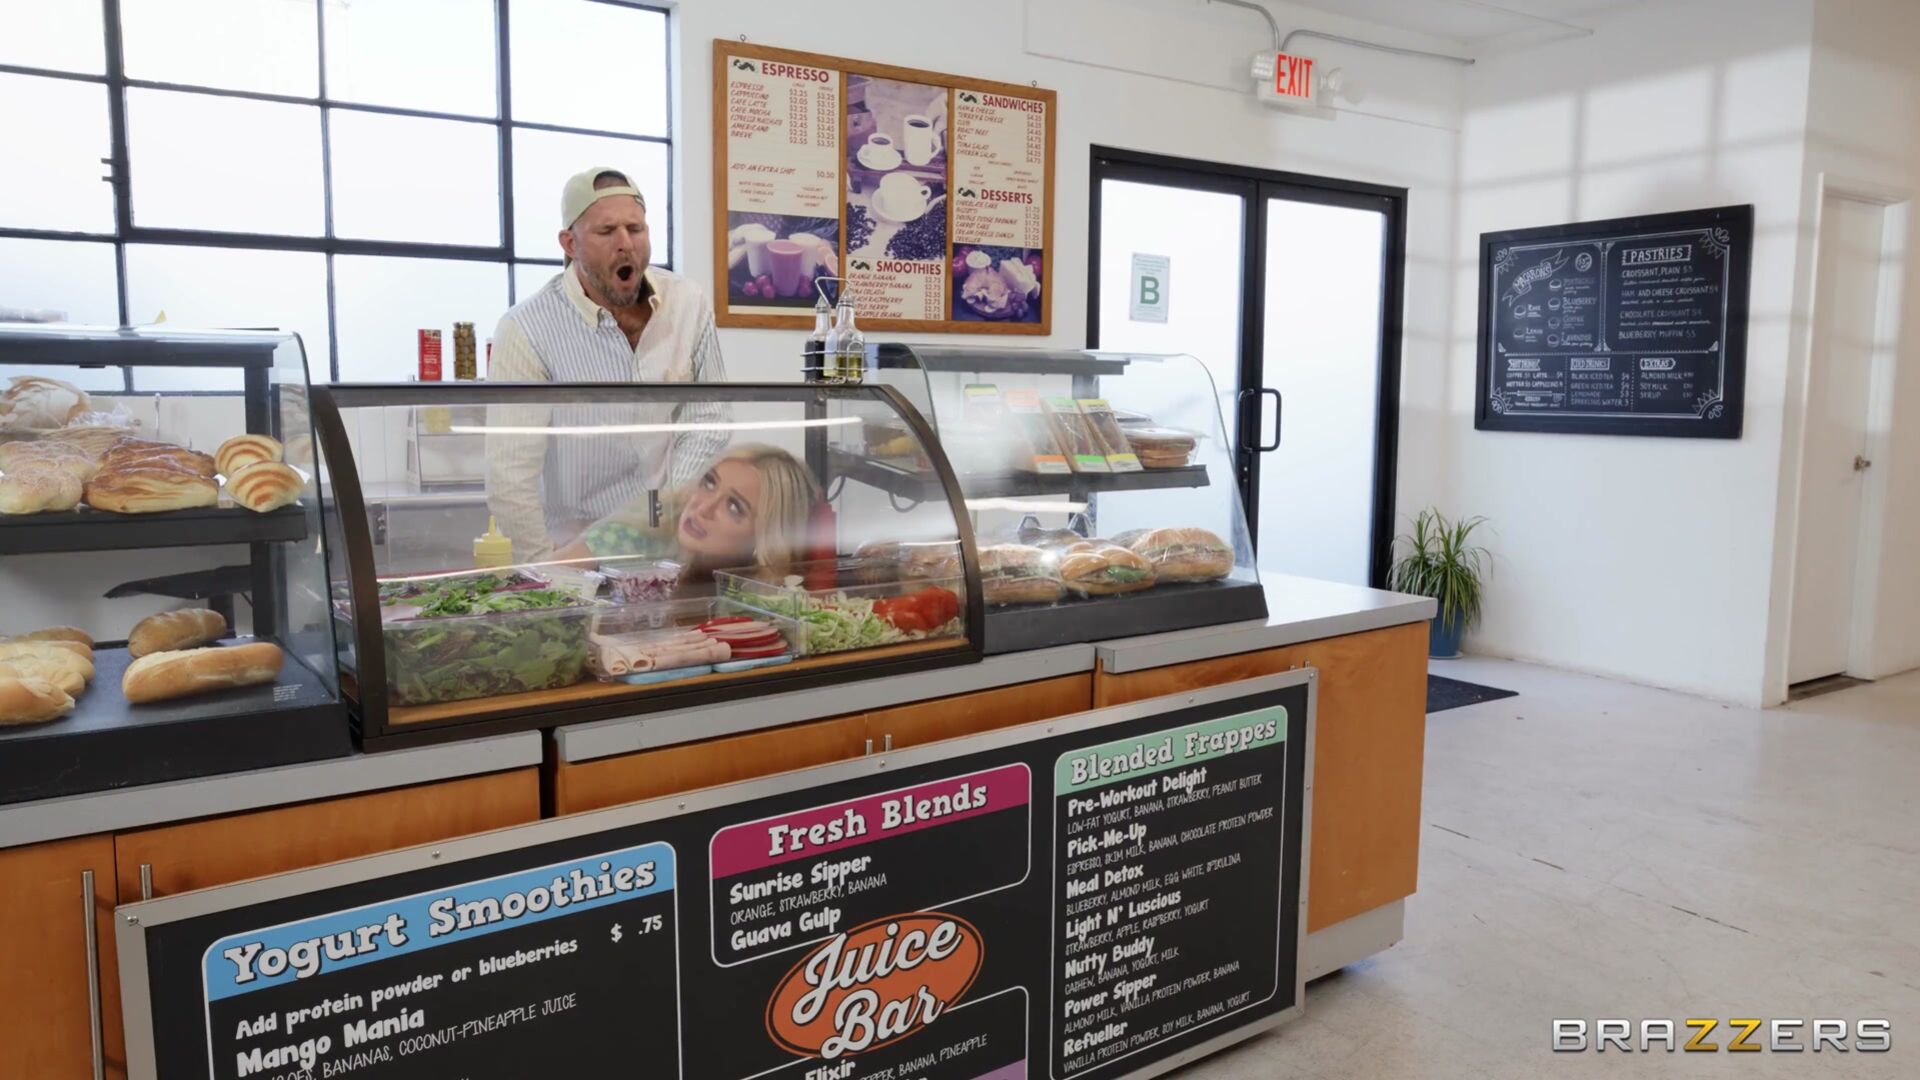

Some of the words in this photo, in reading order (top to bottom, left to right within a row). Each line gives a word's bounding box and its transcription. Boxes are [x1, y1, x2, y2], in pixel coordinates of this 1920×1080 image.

[762, 62, 830, 83] ESPRESSO
[1277, 54, 1312, 98] EXIT
[983, 95, 1043, 114] SANDWICHES
[981, 189, 1033, 204] DESSERTS
[876, 261, 941, 275] SMOOTHIES
[1631, 247, 1683, 263] PASTRIES
[1140, 275, 1160, 305] B
[1638, 289, 1652, 297] AND
[1652, 288, 1673, 297] CHEESE
[1618, 329, 1657, 340] BLUEBERRY
[1071, 737, 1174, 785] Blended
[1184, 719, 1277, 759] Frappes
[1068, 780, 1158, 817] Pre-Workout
[1163, 766, 1207, 794] Delight
[1068, 815, 1101, 835] LOW-FAT
[1103, 809, 1132, 827] YOGURT,
[1212, 779, 1238, 797] PEANUT
[1239, 774, 1262, 790] BUTTER
[768, 809, 867, 857] Fresh
[881, 783, 988, 830] Blends
[1067, 823, 1147, 858] Pick-Me-Up
[1105, 853, 1124, 866] SKIM
[1180, 825, 1217, 843] CHOCOLATE
[1218, 816, 1247, 833] PROTEIN
[1247, 807, 1274, 825] POWDER
[730, 872, 804, 905] Sunrise
[811, 856, 872, 890] Sipper
[730, 901, 776, 926] ORANGE,
[779, 884, 846, 914] STRAWBERRY,
[848, 873, 887, 895] BANANA
[1066, 898, 1109, 917] BLUEBERRY,
[1111, 885, 1140, 906] ALMOND
[1164, 871, 1180, 885] EGG
[1206, 853, 1241, 873] SPIRULINA
[1067, 874, 1099, 899] Meal
[1104, 864, 1144, 886] Detox
[224, 913, 409, 984] Yogurt
[429, 860, 656, 937] Smoothies
[610, 922, 623, 943] $
[638, 914, 663, 935] .75
[731, 920, 792, 951] Guava
[799, 907, 841, 934] Gulp
[1065, 935, 1114, 956] STRAWBERRY,
[1184, 898, 1210, 916] YOGURT
[1066, 913, 1101, 942] Light
[1107, 906, 1124, 926] N'
[1128, 891, 1182, 918] Luscious
[792, 921, 963, 1025] Juice
[1065, 952, 1107, 979] Nutty
[1112, 937, 1155, 962] Buddy
[1161, 946, 1180, 962] MILK
[236, 1012, 277, 1040] Add
[286, 993, 363, 1035] protein
[371, 974, 444, 1012] powder
[451, 966, 473, 984] or
[479, 939, 578, 977] blueberries
[1064, 991, 1108, 1018] Power
[1113, 974, 1158, 1001] Sipper
[1064, 1017, 1095, 1035] ALMOND
[1120, 994, 1151, 1014] VANILLA
[1152, 981, 1182, 1003] PROTEIN
[1213, 960, 1240, 979] BANANA
[236, 1035, 332, 1078] Mango
[343, 1008, 425, 1048] Mania
[323, 1045, 393, 1078] BANANAS,
[399, 1004, 537, 1056] COCONUT-PINEAPPLE
[541, 993, 577, 1016] JUICE
[820, 985, 945, 1060] Bar
[1063, 1052, 1096, 1073] VANILLA
[1097, 1040, 1128, 1061] PROTEIN
[1162, 1023, 1174, 1035] SOY
[1226, 991, 1251, 1009] YOGURT
[1063, 1021, 1128, 1057] Refueller
[898, 1052, 937, 1074] BANANA,
[939, 1033, 988, 1062] PINEAPPLE
